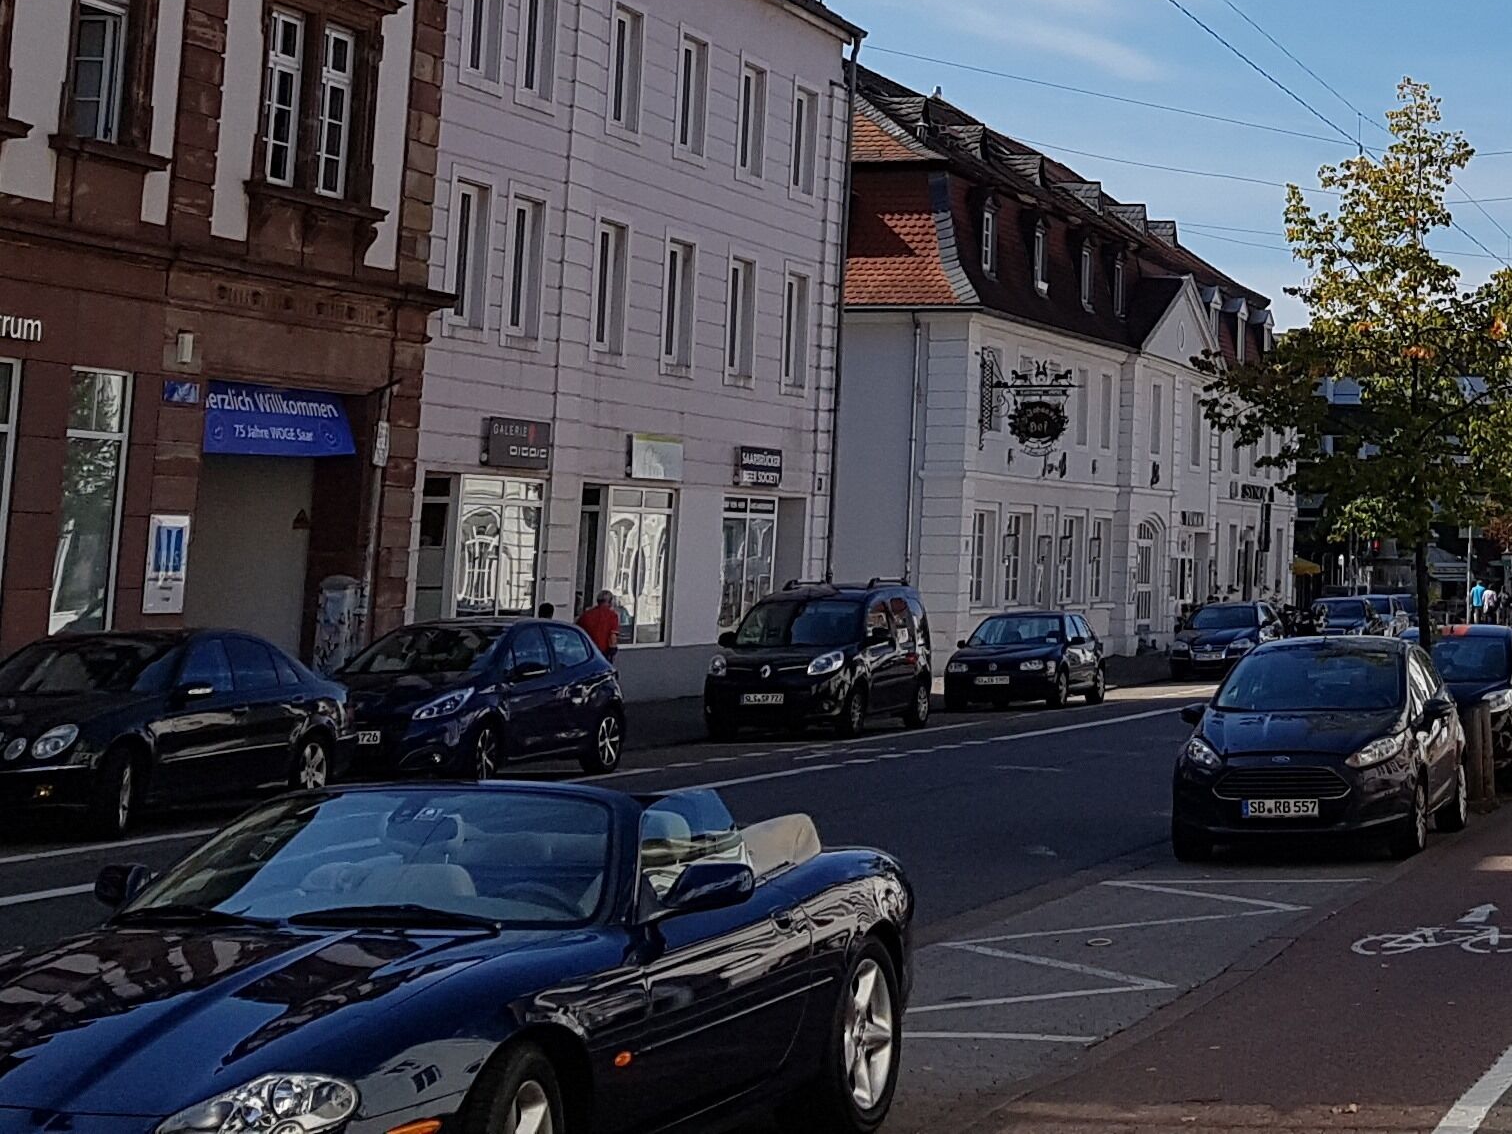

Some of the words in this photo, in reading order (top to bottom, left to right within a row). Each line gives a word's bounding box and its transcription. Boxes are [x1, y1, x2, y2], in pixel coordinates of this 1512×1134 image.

[0, 315, 42, 342] rum
[206, 389, 254, 412] erzlich
[254, 392, 339, 418] Willkommen
[234, 424, 246, 438] 75
[247, 424, 269, 439] Jahre
[493, 422, 528, 438] GALERIE
[742, 451, 781, 467] SAARBRÜCKER
[743, 470, 757, 483] BEER
[757, 471, 780, 484] SOCIETY
[360, 732, 378, 743] 726
[1249, 800, 1266, 814] SB
[1274, 800, 1291, 814] RB
[1293, 800, 1317, 813] 557
